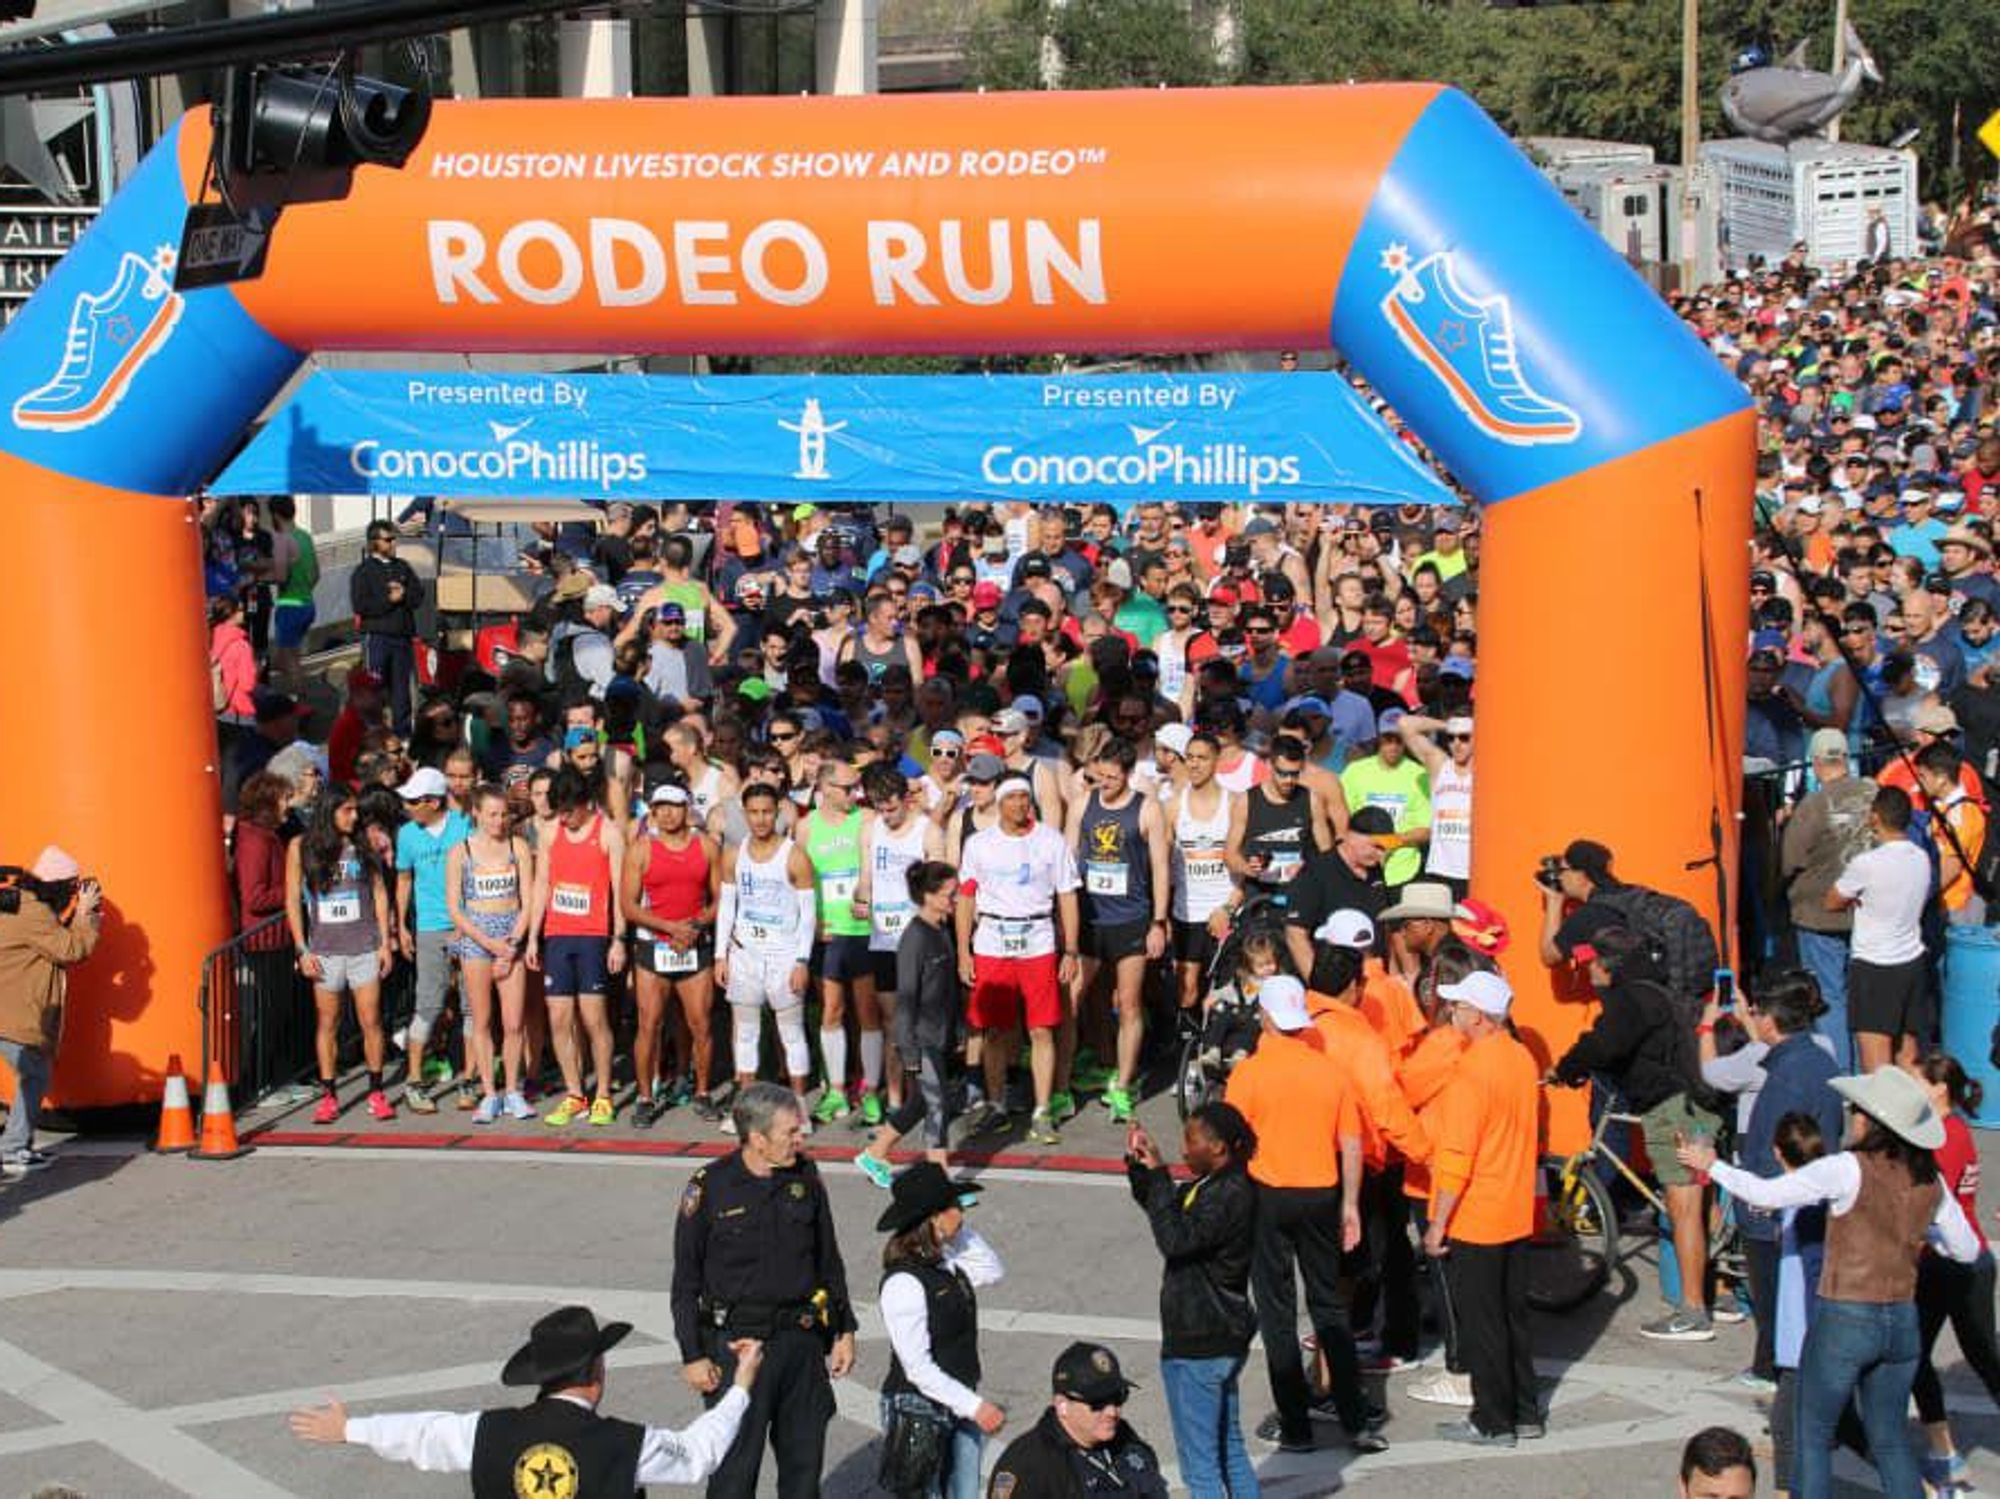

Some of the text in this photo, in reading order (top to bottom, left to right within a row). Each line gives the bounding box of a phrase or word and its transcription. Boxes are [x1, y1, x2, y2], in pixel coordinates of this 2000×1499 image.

[431, 153, 587, 179] HOUSTON
[593, 152, 765, 179] LIVESTOCK
[770, 152, 876, 178] SHOW
[882, 151, 953, 177] AND
[428, 217, 1106, 308] RODEO RUN
[408, 380, 587, 409] Presented By
[1044, 383, 1236, 410] Presented By
[350, 439, 648, 491] ConocoPhillips
[981, 443, 1302, 495] ConocoPhillips
